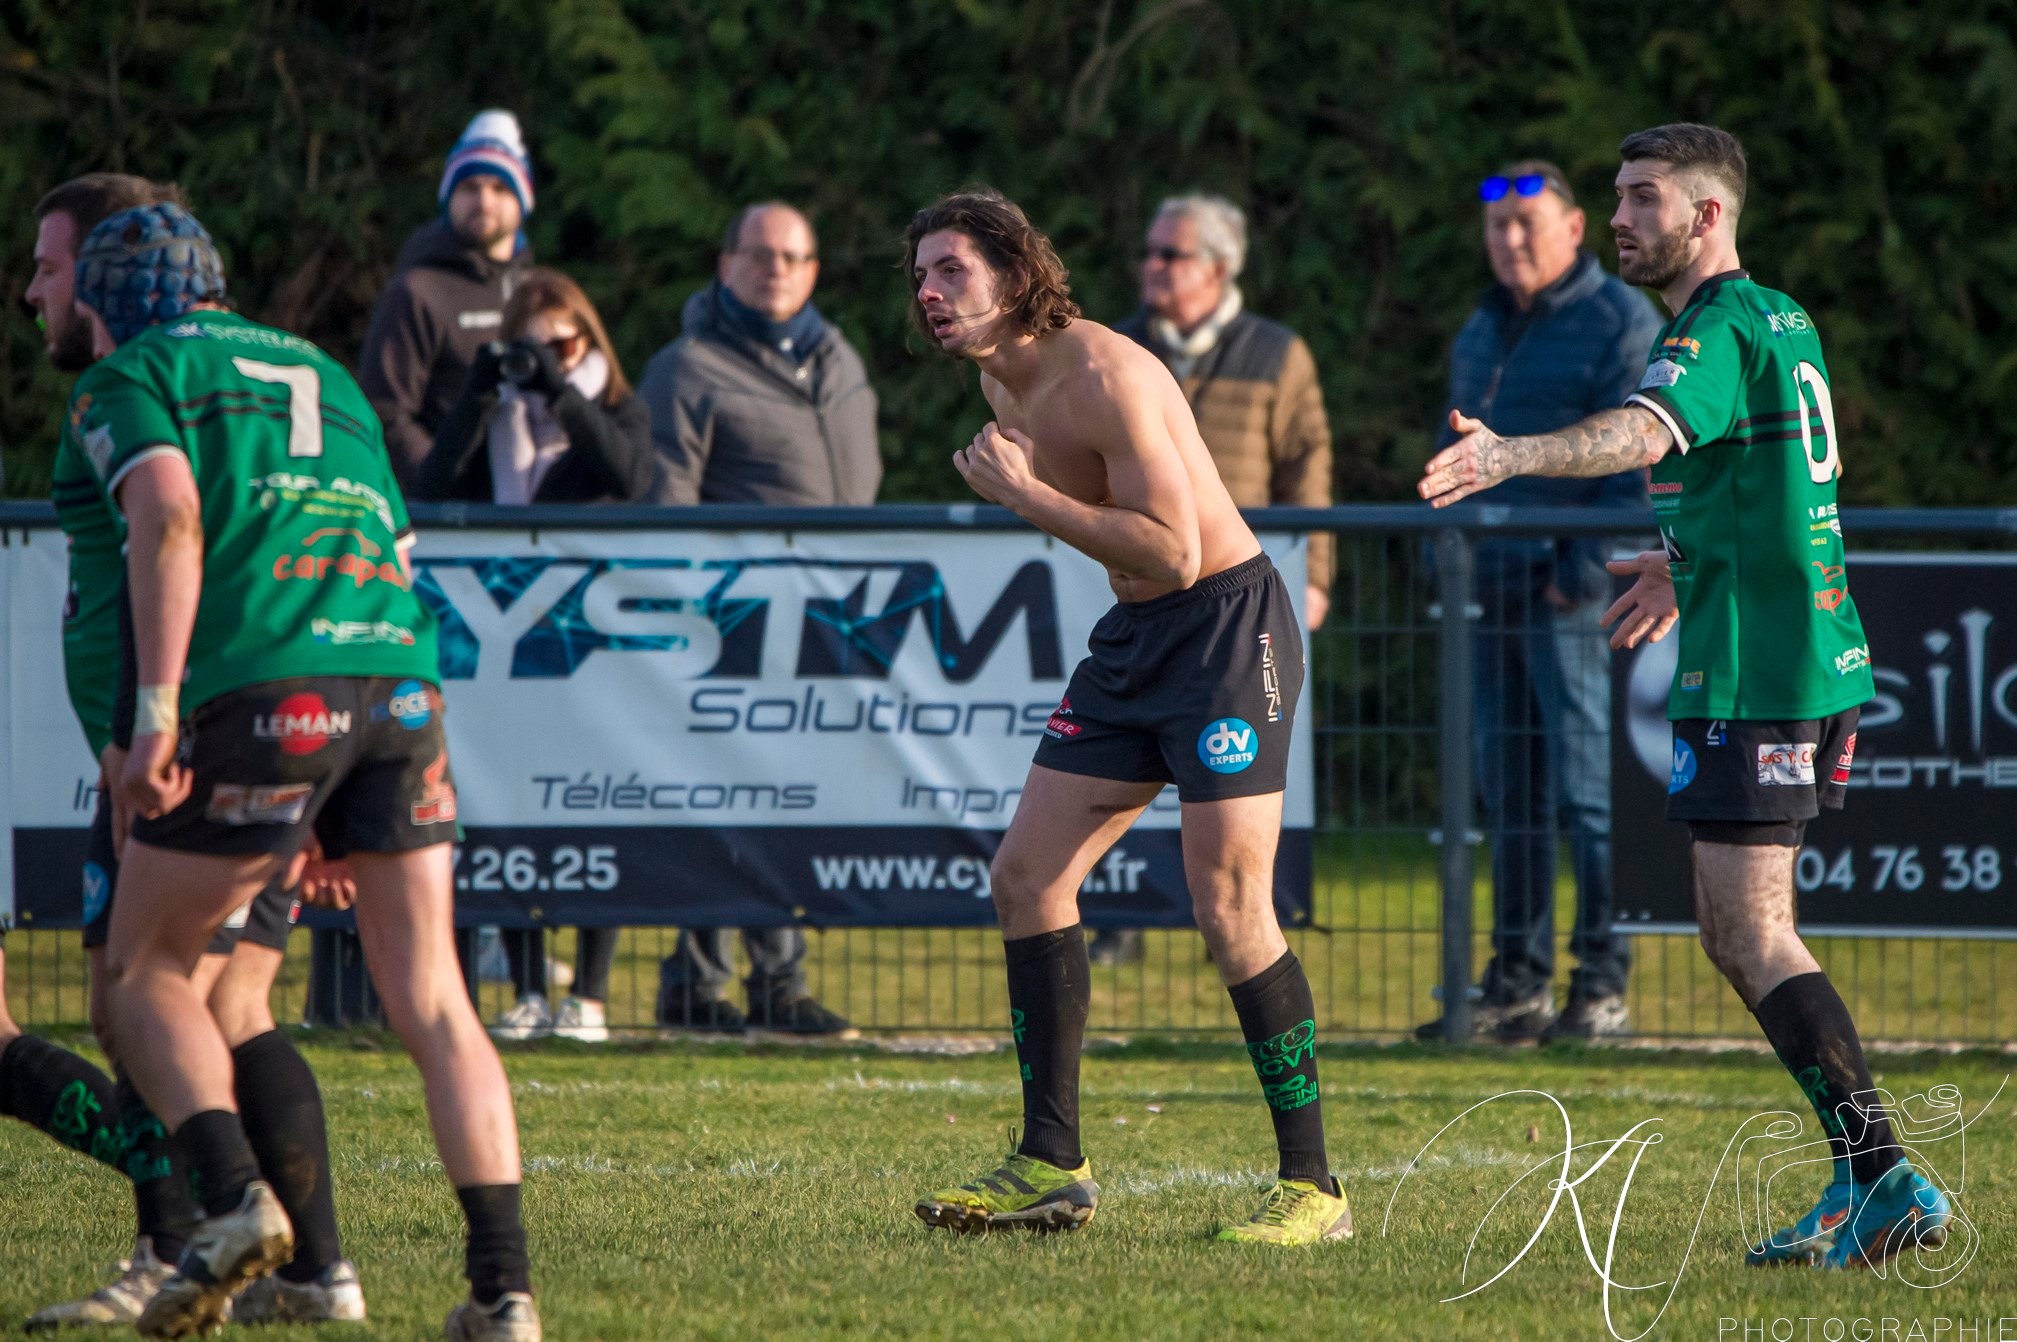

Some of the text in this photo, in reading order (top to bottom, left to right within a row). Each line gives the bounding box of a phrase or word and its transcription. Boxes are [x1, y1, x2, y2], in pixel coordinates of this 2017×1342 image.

[231, 356, 323, 458] 7
[253, 710, 352, 738] LEMAN
[688, 684, 1056, 738] Solutions
[1210, 752, 1253, 765] EXPERTS
[532, 772, 817, 810] Télécoms
[1796, 847, 2001, 892] 04 76 38
